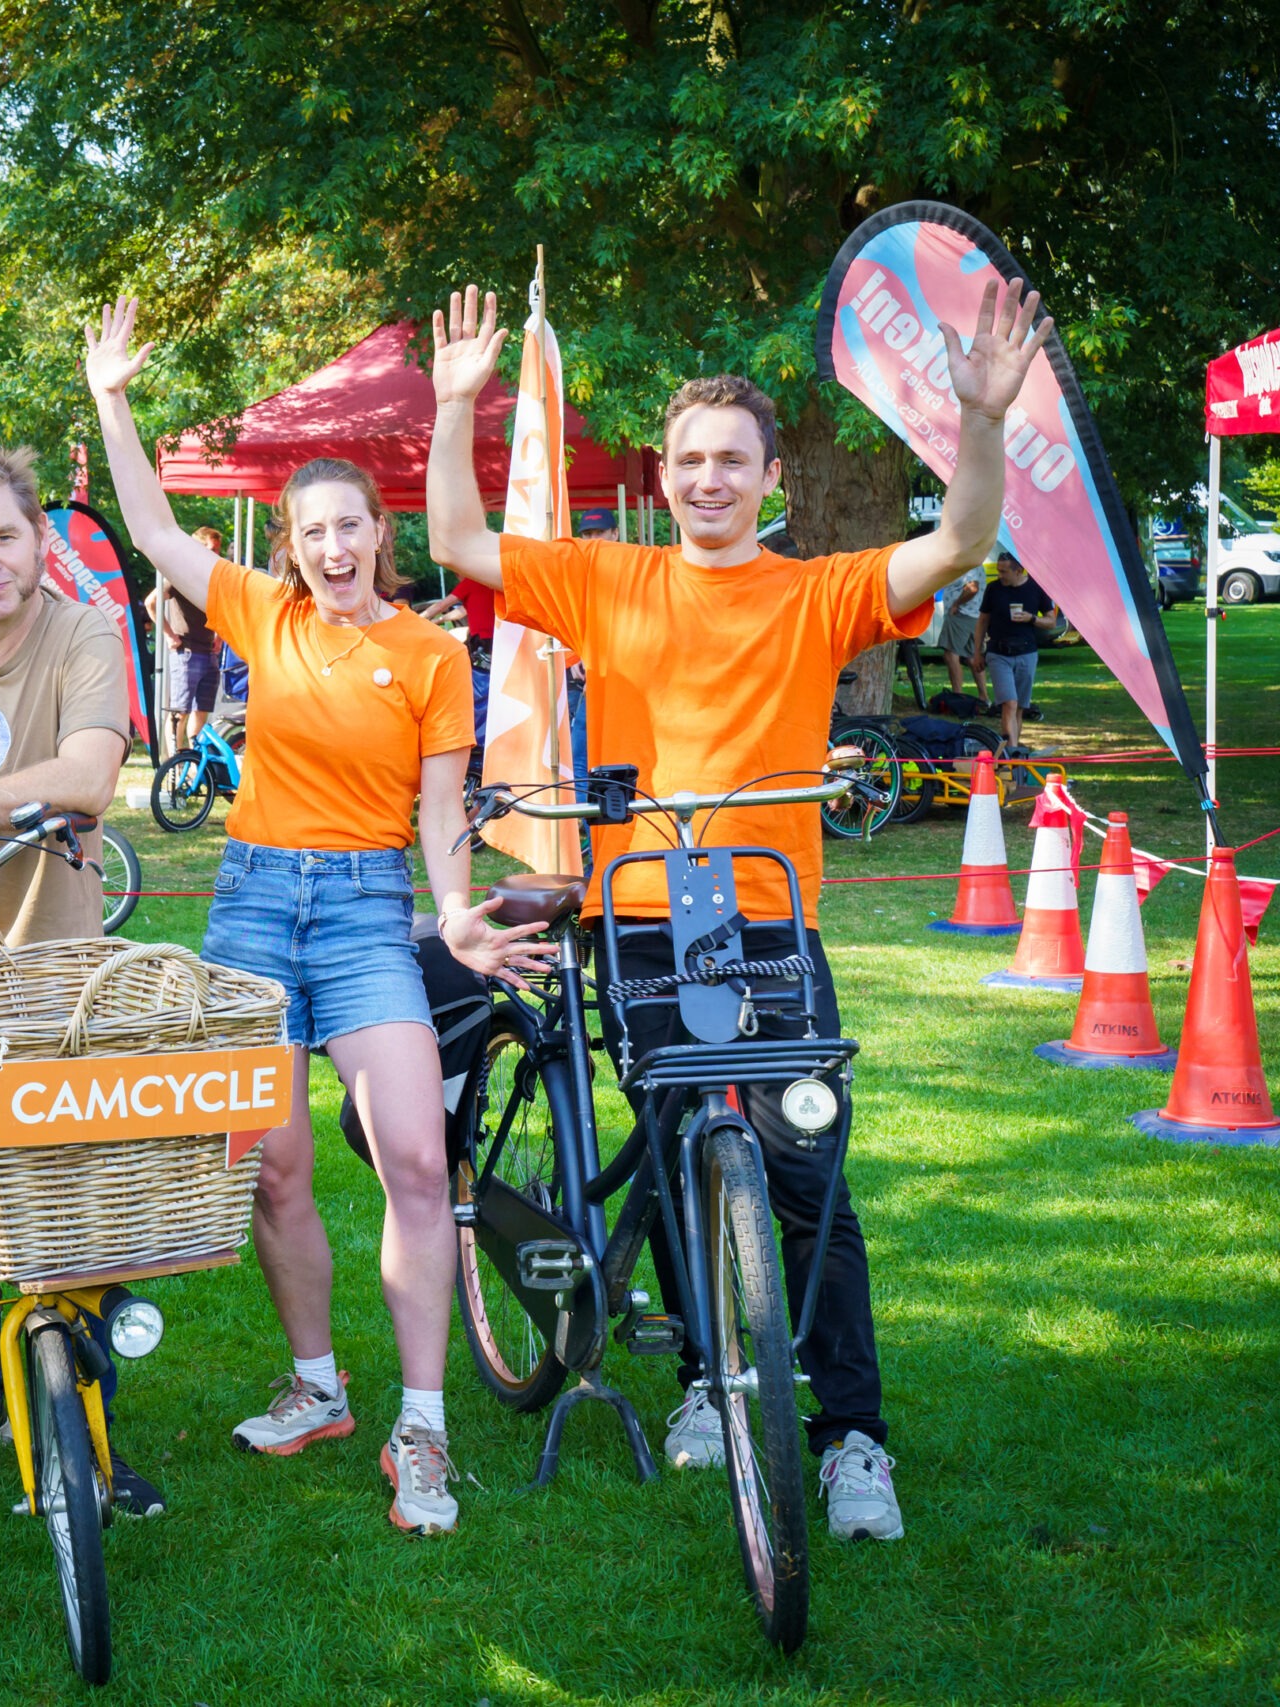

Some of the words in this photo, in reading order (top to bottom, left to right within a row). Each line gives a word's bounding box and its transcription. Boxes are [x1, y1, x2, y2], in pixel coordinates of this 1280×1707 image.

[1091, 1023, 1139, 1037] ATKINS
[11, 1066, 277, 1125] CAMCYCLE
[1211, 1092, 1262, 1105] ATKINS
